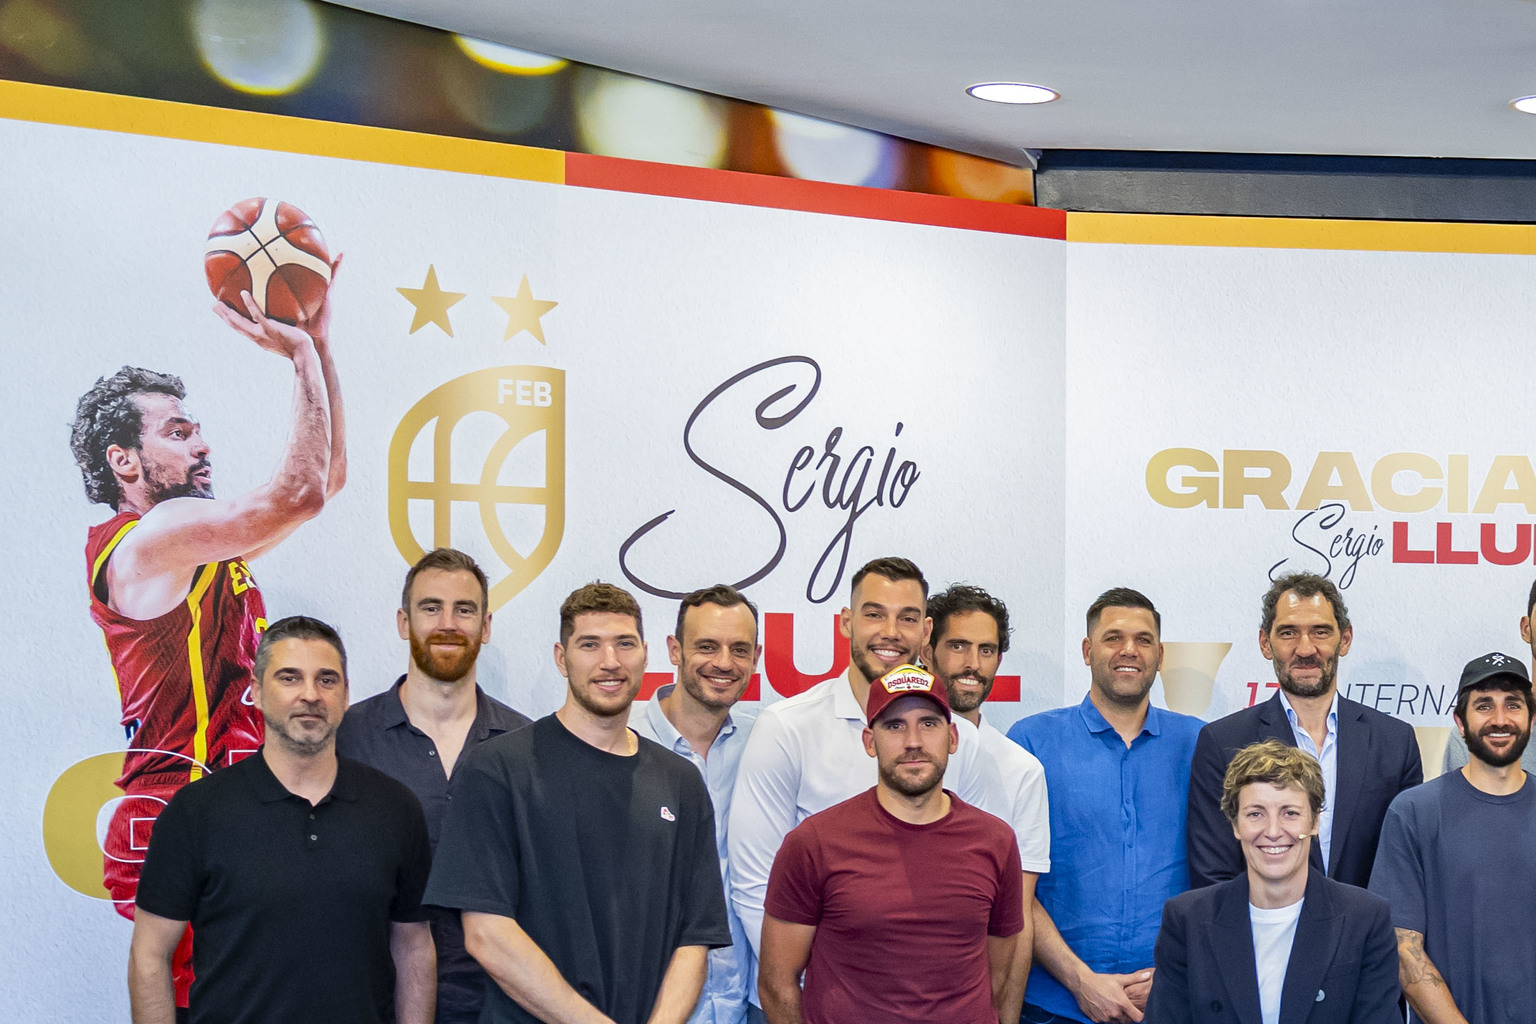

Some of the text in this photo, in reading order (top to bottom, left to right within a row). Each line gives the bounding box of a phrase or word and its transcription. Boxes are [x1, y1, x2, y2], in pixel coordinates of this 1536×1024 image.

[498, 378, 553, 408] FEB
[619, 355, 920, 603] Sergio
[1269, 503, 1384, 589] Sergio
